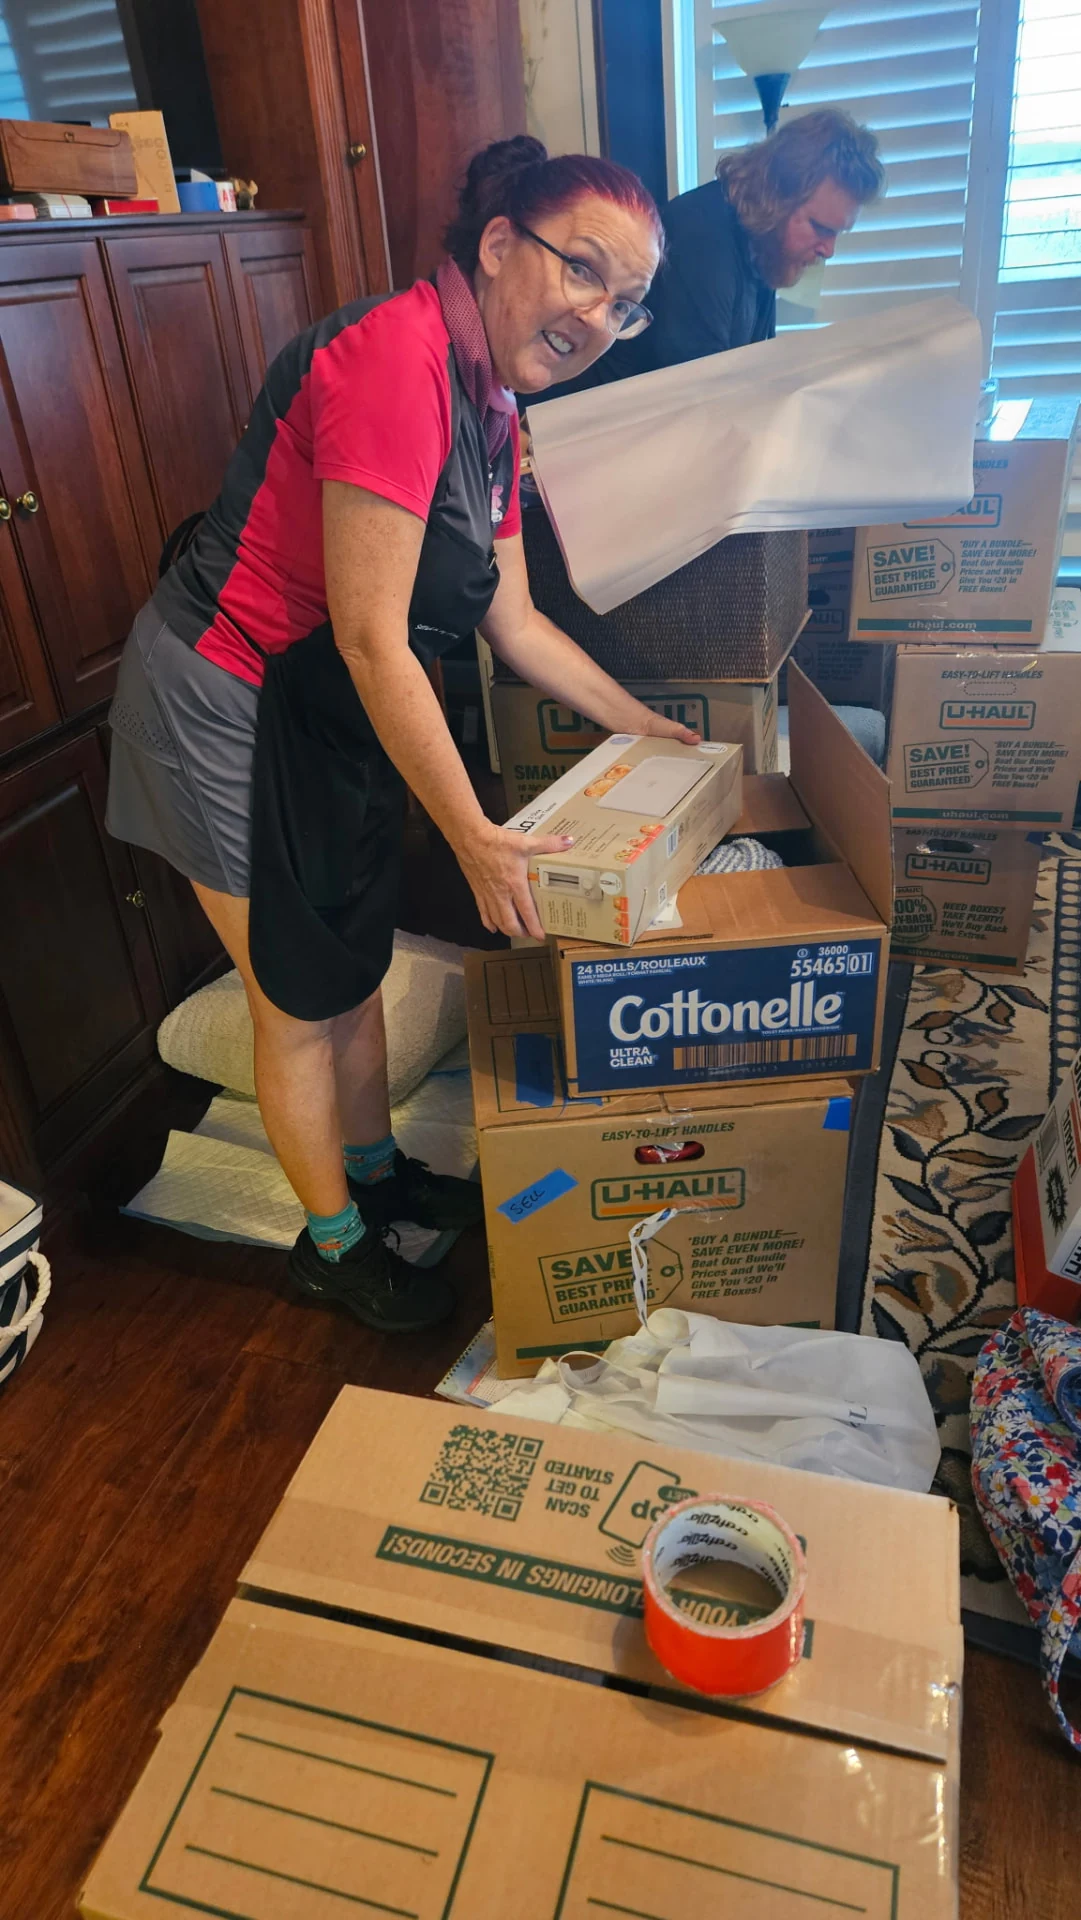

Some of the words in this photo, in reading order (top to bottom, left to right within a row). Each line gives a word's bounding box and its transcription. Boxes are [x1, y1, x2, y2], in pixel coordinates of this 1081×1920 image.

[973, 460, 1008, 469] ANDLES
[981, 540, 988, 548] A
[873, 545, 936, 567] SAVE!
[960, 558, 979, 566] Beat
[980, 558, 995, 566] Our
[996, 558, 1024, 566] Bundle
[961, 549, 983, 558] SAVE
[984, 549, 1006, 558] EVEN
[1008, 550, 1037, 558] MORE!
[874, 573, 901, 585] BEST
[903, 568, 936, 581] PRICE
[959, 576, 976, 584] Give
[978, 576, 992, 584] You
[960, 567, 982, 576] Prices
[984, 567, 999, 576] and
[908, 620, 977, 630] uhaul.com
[941, 670, 1000, 679] EASY-TO-LIFT
[1002, 670, 1043, 679] HANDLES
[947, 706, 1029, 719] U-HAUL
[910, 744, 970, 762] SAVE!
[910, 768, 935, 779] BEST
[938, 765, 970, 776] PRICE
[912, 858, 986, 875] U-HAUL
[894, 898, 928, 914] 00%
[944, 902, 968, 912] NEED
[894, 914, 932, 924] Y-BACK
[944, 912, 965, 920] TAKE
[985, 923, 1008, 933] Back
[818, 945, 848, 956] 36000
[576, 965, 594, 976] 24
[595, 956, 706, 974] ROLLS/ROULEAUX
[790, 956, 846, 978] 55465
[849, 957, 869, 974] 01
[609, 980, 842, 1042] Cottonelle
[610, 1047, 650, 1058] ULTRA
[610, 1056, 654, 1068] CLEAN
[602, 1126, 680, 1142] EASY-TO-LIFT
[682, 1122, 734, 1136] HANDLES
[602, 1176, 736, 1203] U-HAUL
[720, 1232, 730, 1244] A
[692, 1244, 724, 1258] SAVE
[727, 1242, 760, 1255] EVEN
[763, 1238, 805, 1252] MORE!
[692, 1256, 719, 1269] Beat
[722, 1255, 744, 1267] Our
[746, 1252, 786, 1264] Bundle
[692, 1266, 727, 1280] Prices
[730, 1264, 754, 1276] and
[756, 1262, 786, 1274] We'll
[556, 1284, 598, 1302] BEST
[602, 1271, 653, 1294] PRI
[692, 1278, 717, 1290] Give
[719, 1276, 742, 1288] You
[743, 1275, 764, 1287] $20
[767, 1274, 778, 1285] in
[559, 1288, 660, 1316] GUARANTED
[692, 1288, 722, 1301] FREE
[724, 1286, 763, 1299] Boxes!
[544, 1460, 614, 1486] STARTED
[544, 1480, 575, 1498] GET
[579, 1484, 600, 1501] TO
[545, 1496, 591, 1518] SCAN
[631, 1500, 669, 1521] pp
[384, 1534, 493, 1572] SECONDS!
[496, 1559, 522, 1581] IN
[526, 1566, 643, 1605] LONGINGS
